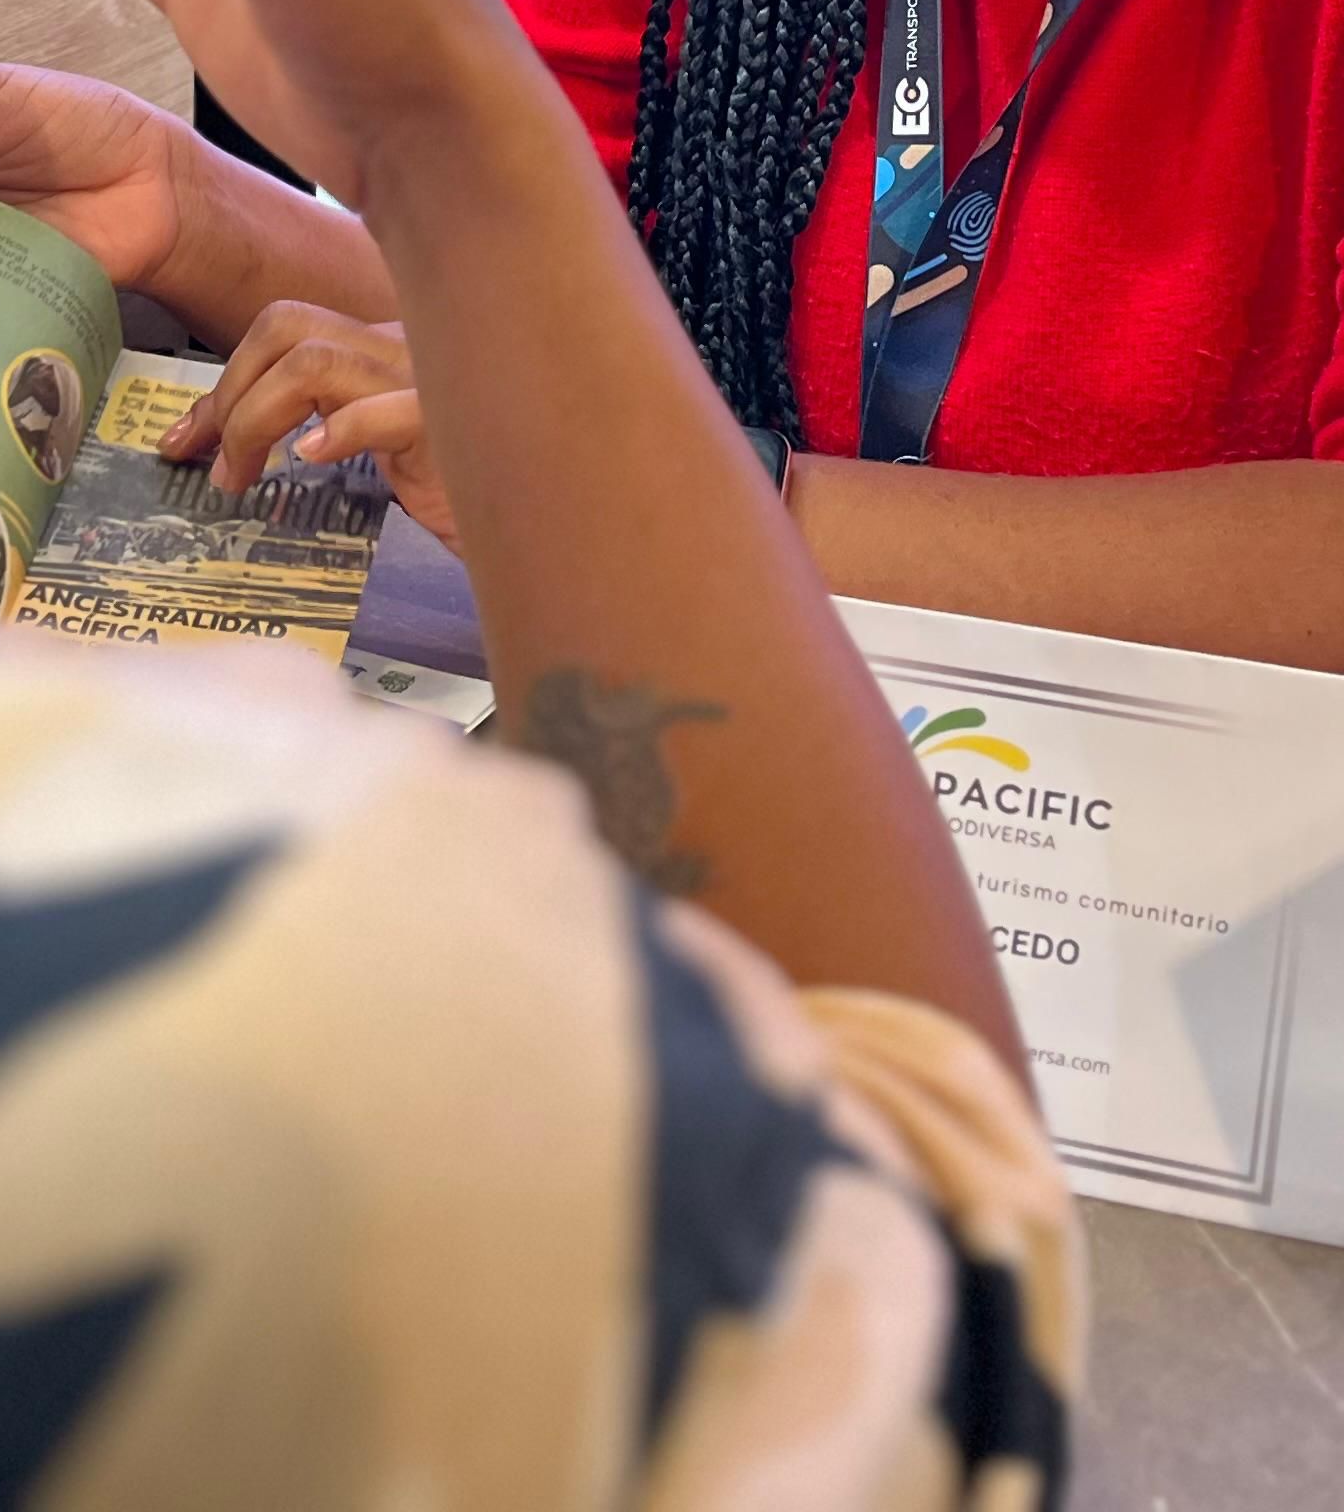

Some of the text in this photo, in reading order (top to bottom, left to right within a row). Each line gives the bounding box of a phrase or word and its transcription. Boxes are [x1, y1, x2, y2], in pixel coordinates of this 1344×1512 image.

[892, 76, 930, 136] EC
[15, 606, 160, 646] PACÍFICA
[24, 583, 289, 640] ANCESTRALIDAD
[933, 771, 1113, 831] PACIFIC
[948, 816, 1057, 851] ODIVERSA
[975, 870, 1230, 935] turismo comunitario
[991, 925, 1080, 966] CEDO
[1029, 1046, 1111, 1076] ersa.com
